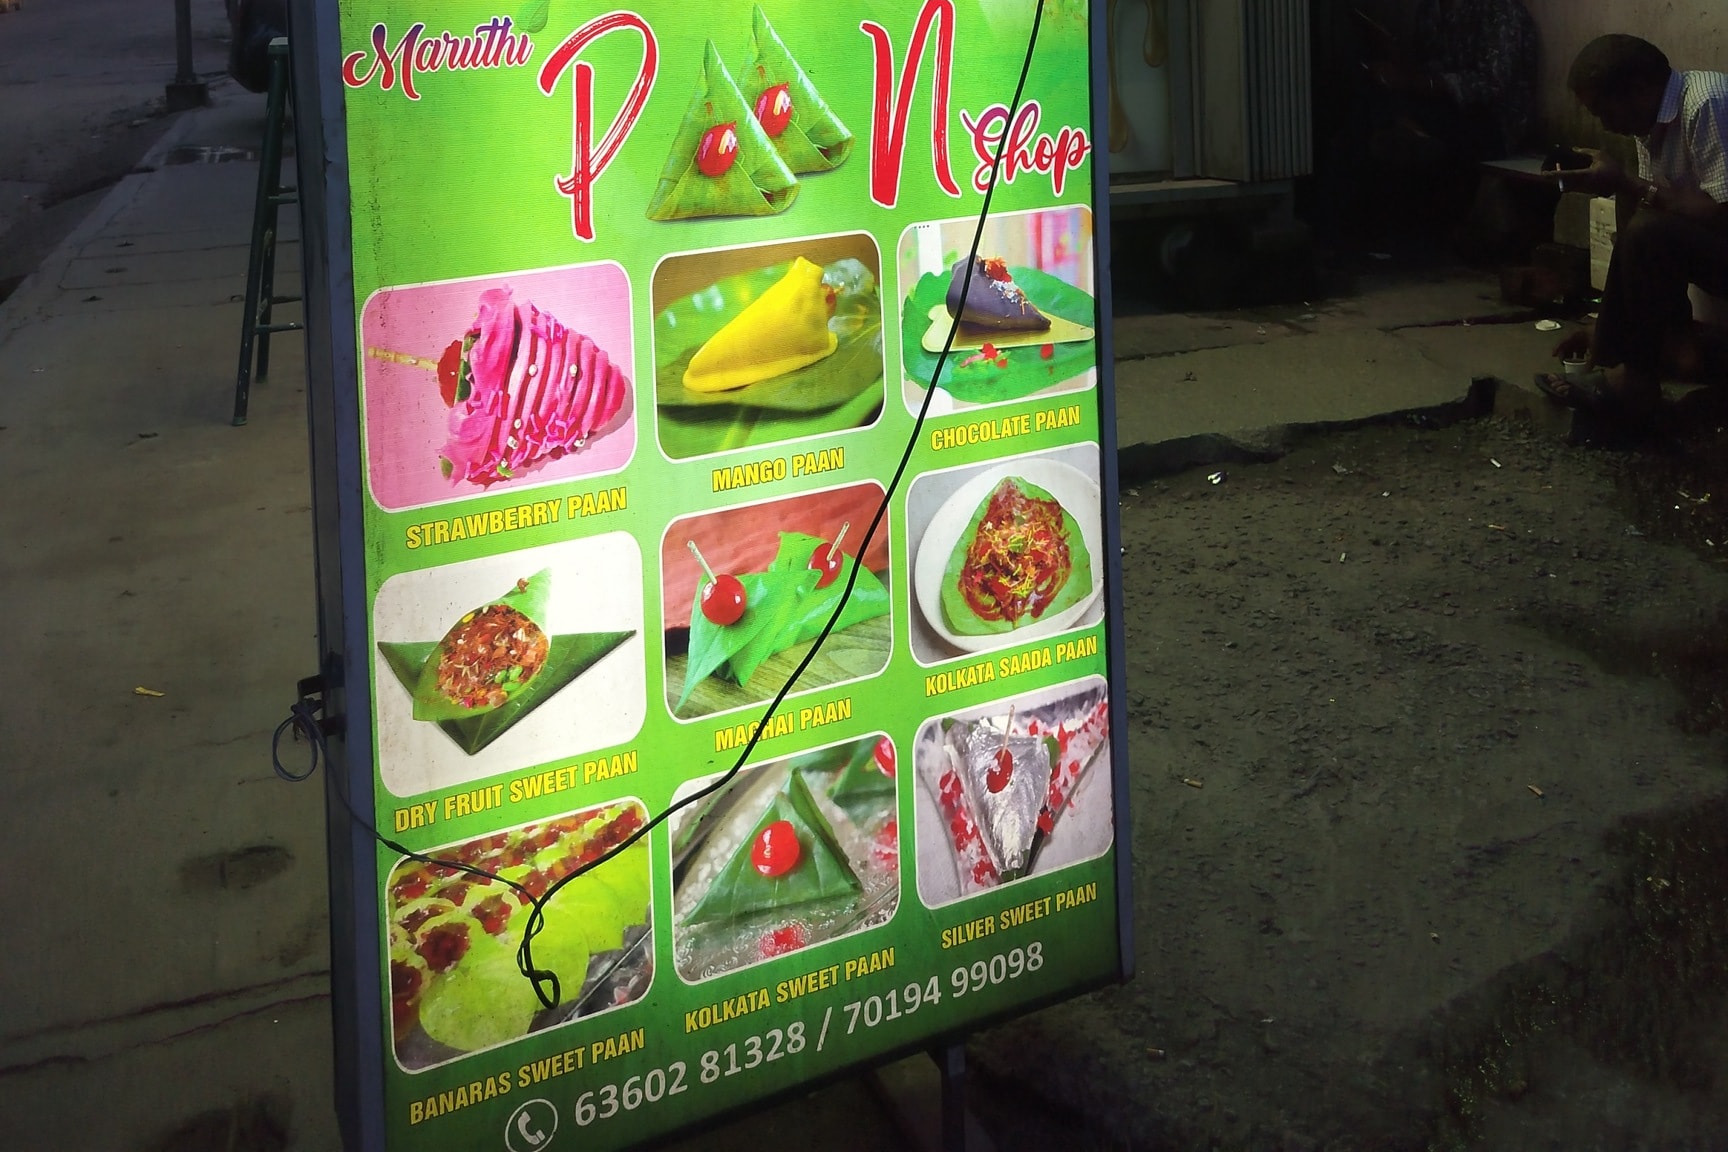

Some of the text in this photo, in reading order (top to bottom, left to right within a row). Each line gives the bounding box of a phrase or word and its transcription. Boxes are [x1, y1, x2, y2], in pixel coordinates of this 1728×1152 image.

[342, 14, 533, 101] Maruthi
[960, 99, 1093, 198] Shop
[931, 405, 1081, 451] CHOCOLATE PAAN
[712, 447, 845, 493] MANGO PAAN
[405, 486, 628, 550] STRAWBERRY PAAN
[924, 636, 1098, 698] KOLKATA SAADA PAAN
[799, 697, 852, 731] PAAN
[394, 750, 639, 834] DRY FRUIT SWEET PAAN
[941, 881, 1098, 950] SILVER SWEET PAAN
[684, 946, 896, 1034] KOLKATA SWEET PAAN
[574, 1060, 689, 1128] 63602
[699, 1020, 807, 1085] 81328
[843, 980, 942, 1035] 70194
[950, 940, 1045, 1000] 99098
[409, 1027, 646, 1126] BANARAS SWEET PAAN
